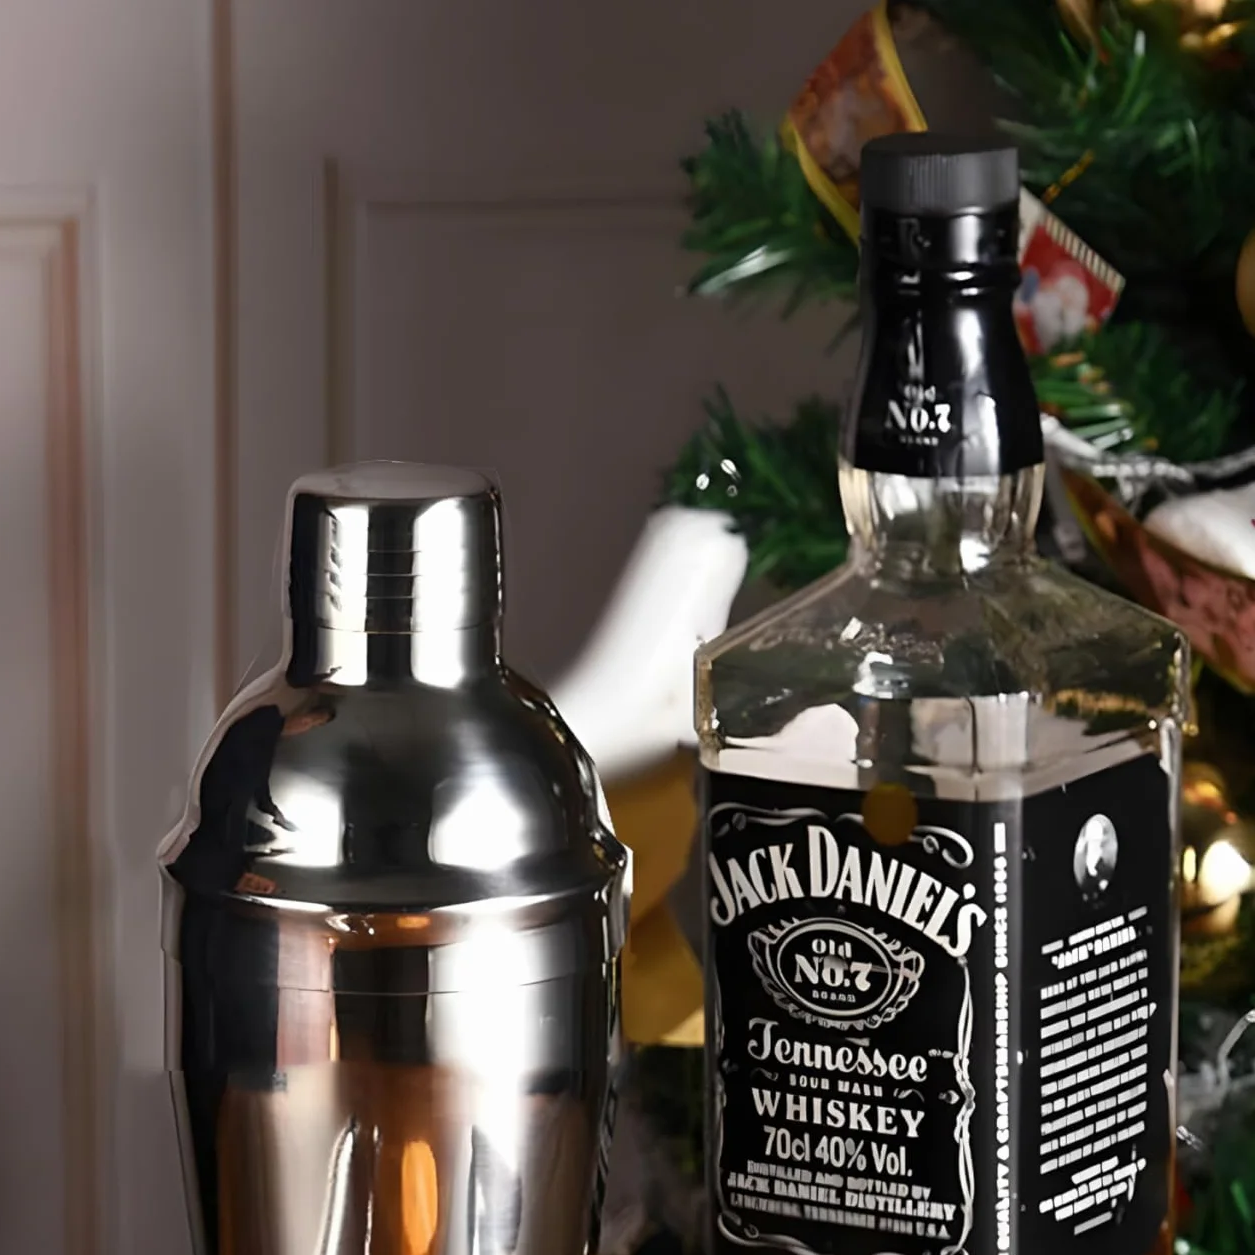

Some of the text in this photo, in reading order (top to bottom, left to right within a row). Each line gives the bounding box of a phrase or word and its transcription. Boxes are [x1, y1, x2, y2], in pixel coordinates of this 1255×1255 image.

[708, 842, 805, 926] JACK
[807, 824, 988, 958] DANIEL'S
[811, 938, 852, 959] Old
[747, 1017, 928, 1082] Tennessee
[751, 1087, 925, 1138] WHISKEY
[763, 1125, 811, 1162] 70cl
[814, 1135, 867, 1172] 40%
[871, 1141, 913, 1177] Vol.
